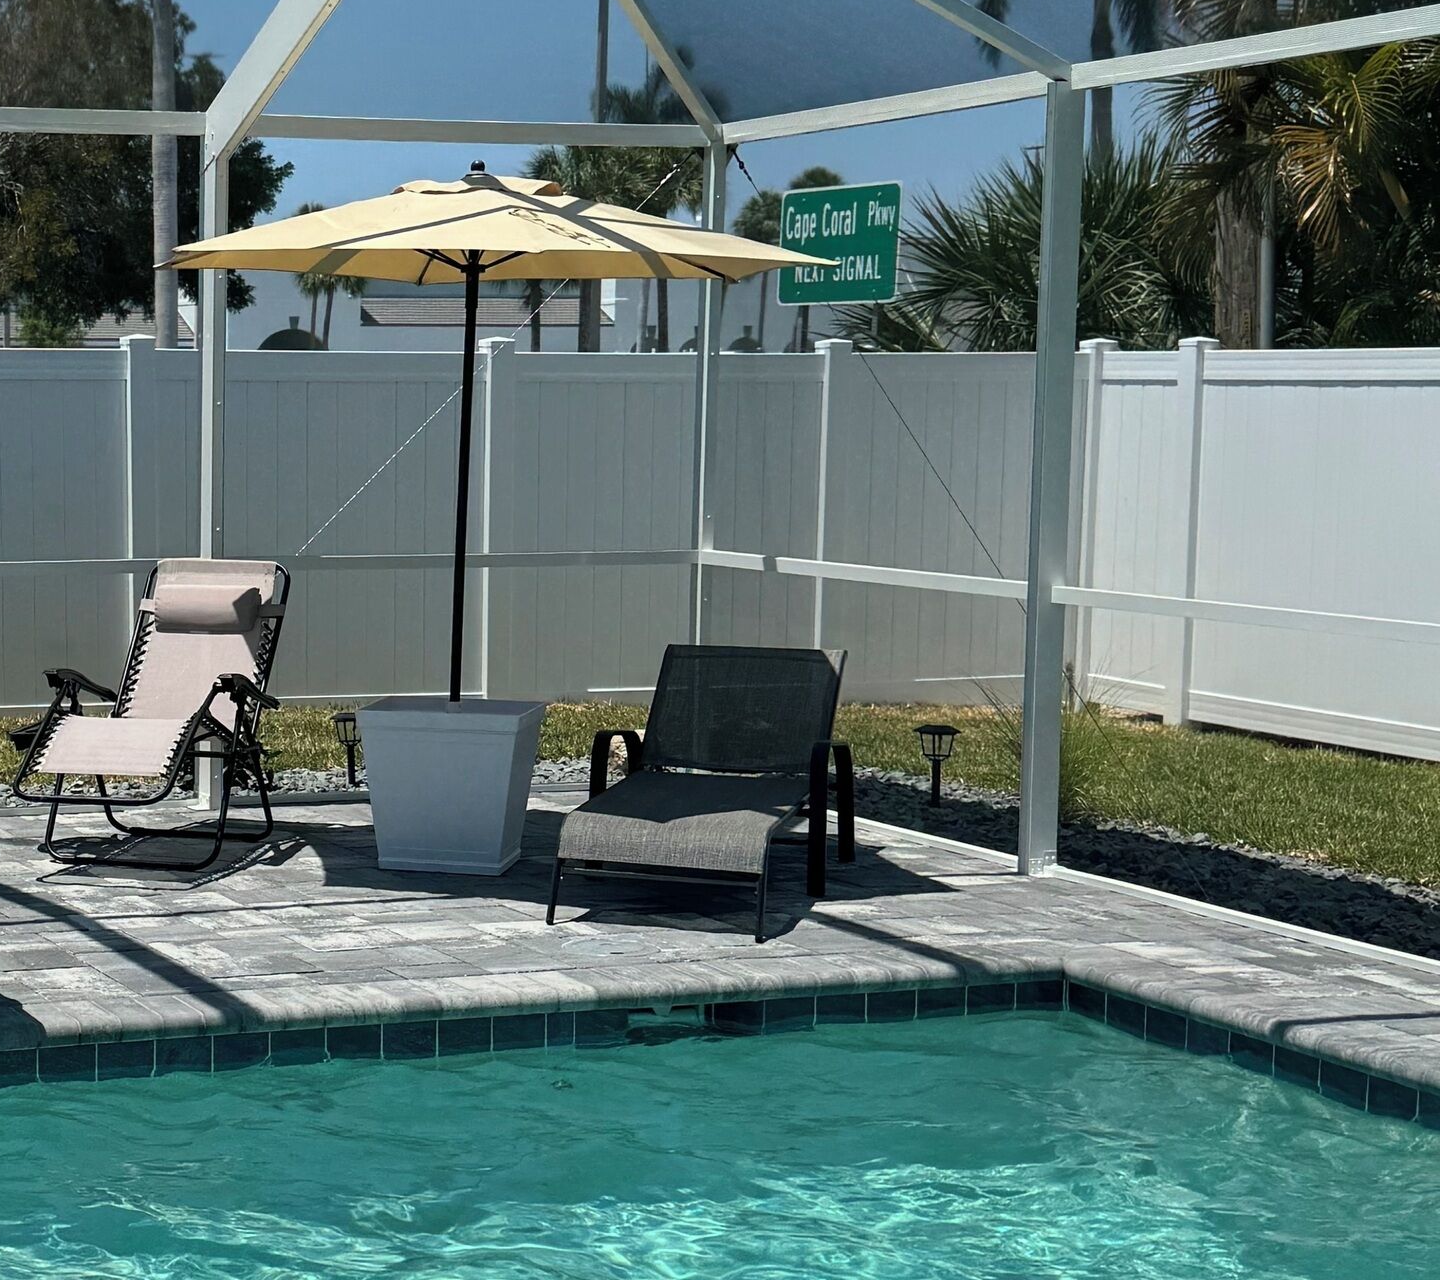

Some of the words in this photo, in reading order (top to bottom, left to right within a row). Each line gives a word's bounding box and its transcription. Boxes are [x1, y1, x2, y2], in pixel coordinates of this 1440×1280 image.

[786, 206, 817, 246] Cape
[822, 202, 857, 237] Coral
[867, 201, 896, 232] Pkwy
[832, 254, 882, 281] SIGNAL
